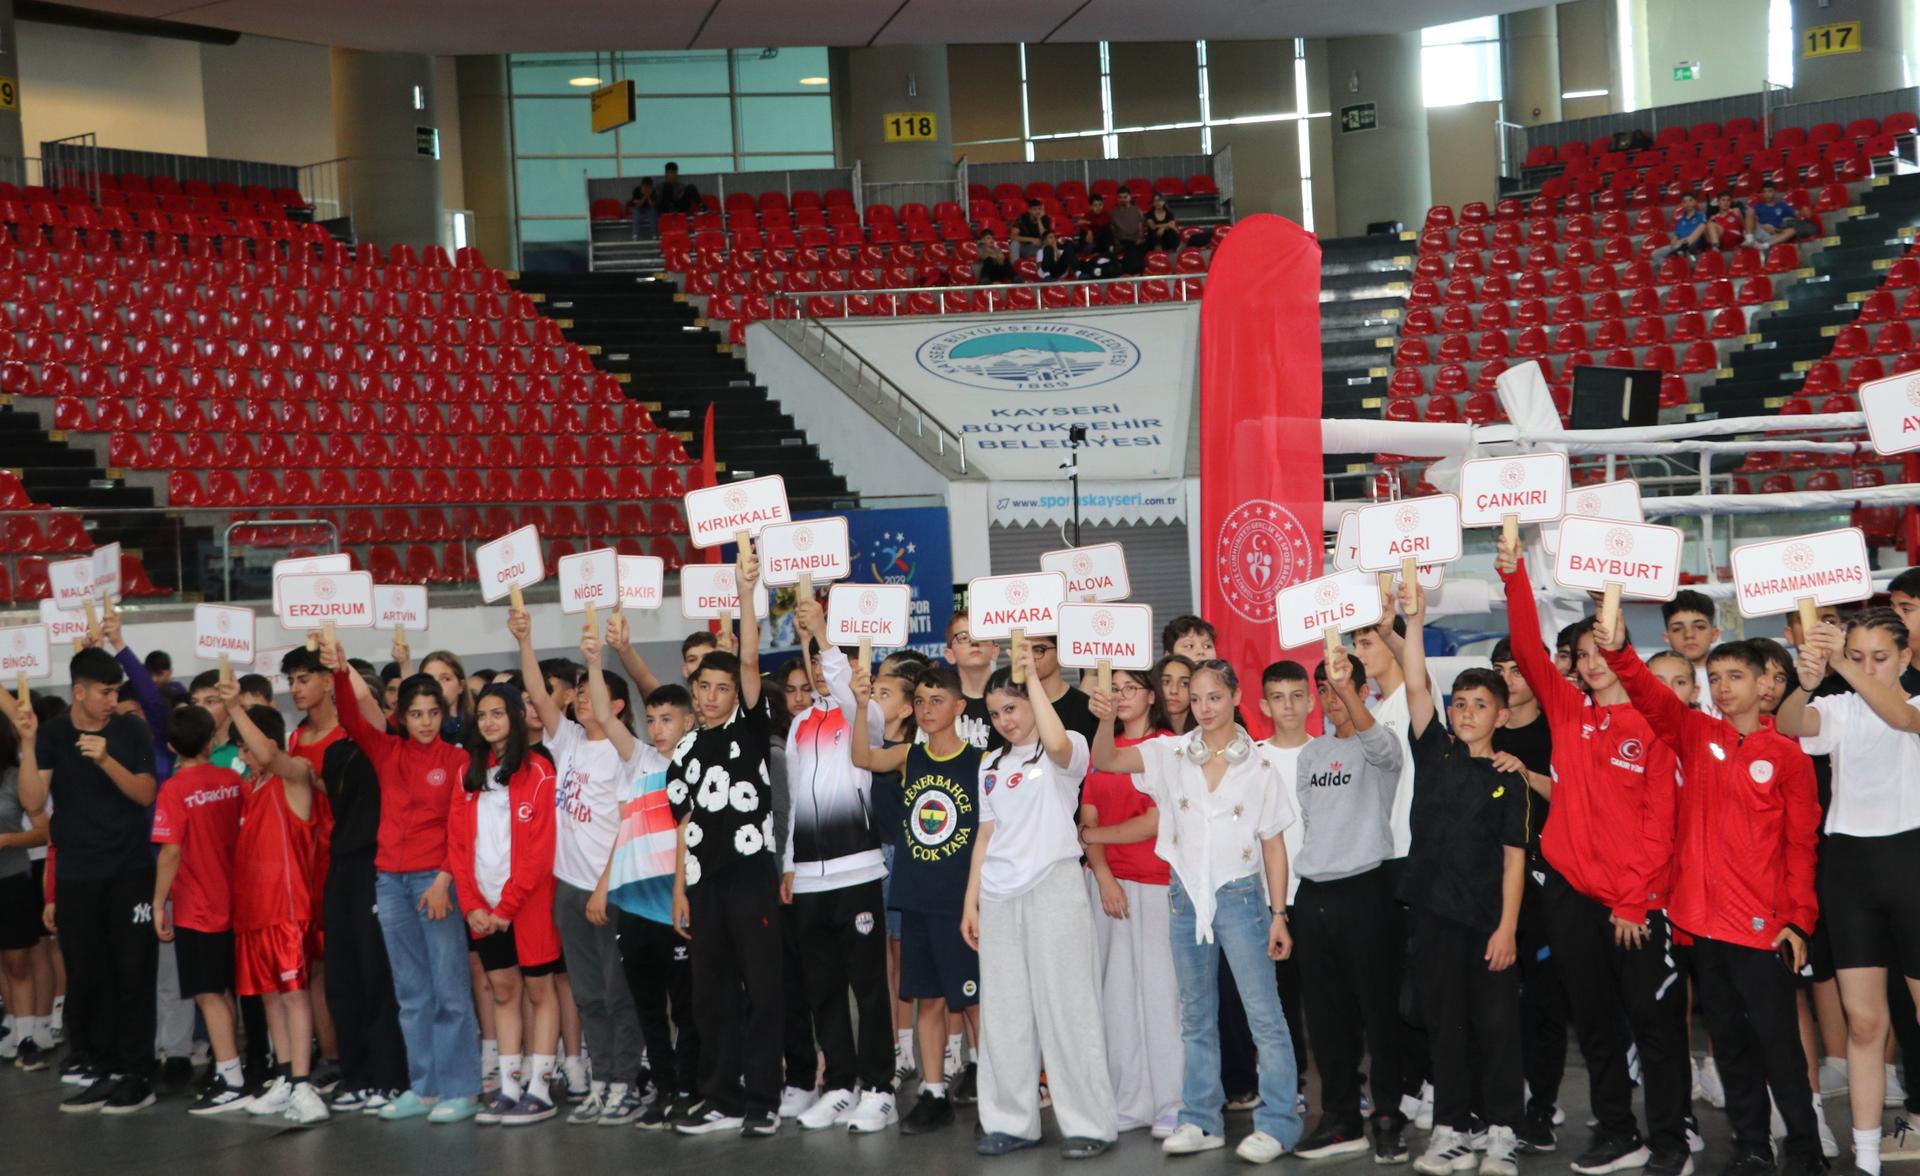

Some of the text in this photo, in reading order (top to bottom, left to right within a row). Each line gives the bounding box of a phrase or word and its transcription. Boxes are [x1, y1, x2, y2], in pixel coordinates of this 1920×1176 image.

[1808, 27, 1852, 52] 117
[2, 83, 13, 105] 9
[891, 117, 931, 136] 118
[991, 403, 1121, 417] KAYSERİ
[1476, 490, 1547, 512] ÇANKIRI
[697, 505, 782, 534] KIRIKKALE
[1388, 535, 1430, 555] AĞRI
[496, 561, 526, 584] ORDU
[769, 554, 839, 572] İSTANBUL
[1569, 555, 1663, 581] BAYBURT
[574, 580, 604, 600] NİĞDE
[1743, 565, 1863, 599] KAHRAMANMARAŞ
[288, 603, 366, 618] ERZURUM
[383, 609, 417, 621] ARTVİN
[983, 606, 1053, 625] ANKARA
[1304, 602, 1356, 630] BİTLİS
[840, 617, 892, 634] BİLECİK
[199, 635, 250, 651] ADIYAMAN
[1072, 641, 1136, 657] BATMAN
[3, 654, 38, 669] BİNGÖL
[184, 785, 240, 808] TÜRKİYE
[912, 845, 940, 861] ÇOK
[941, 827, 971, 856] YAŞA
